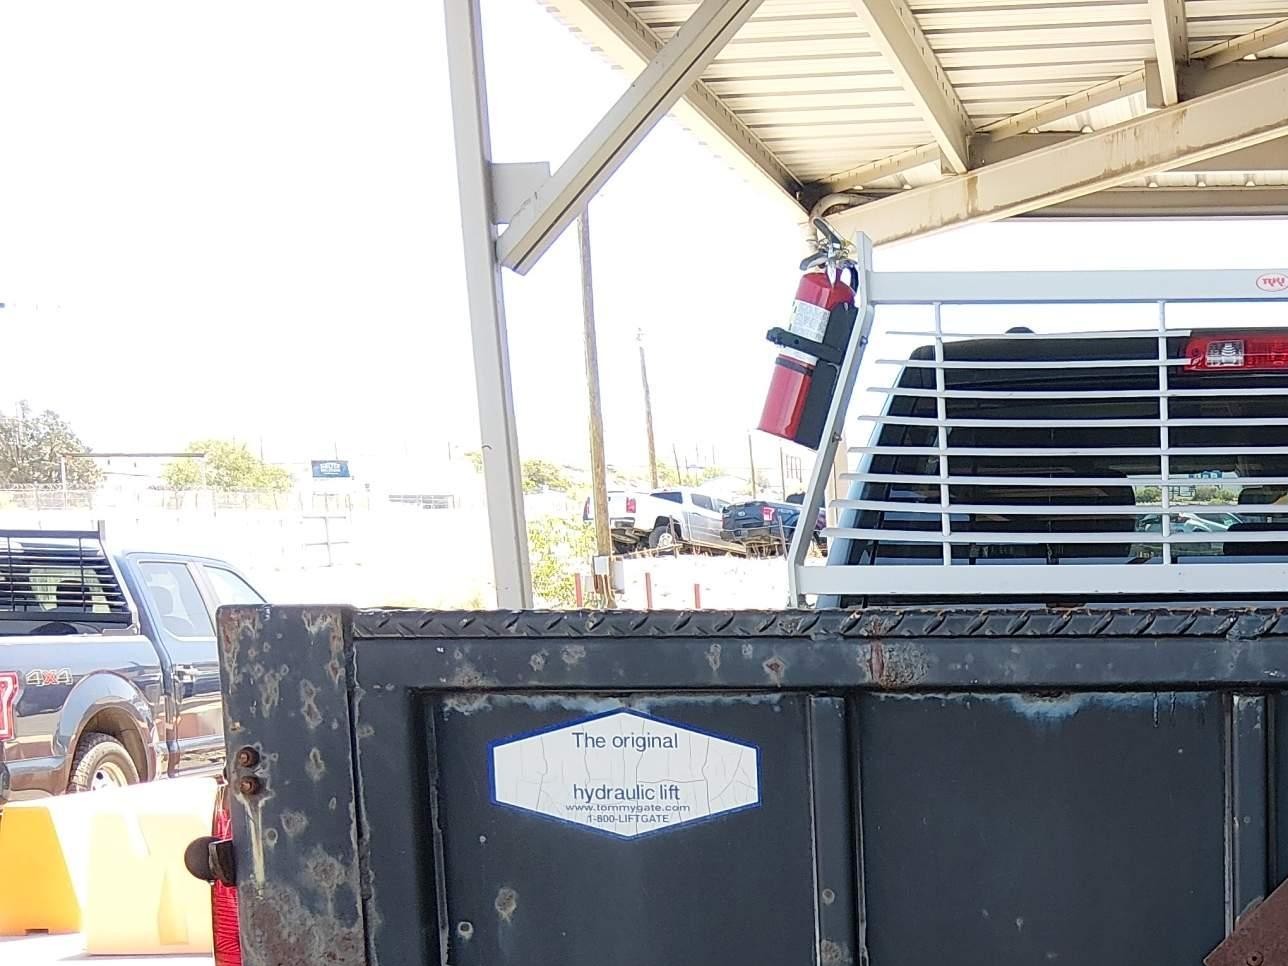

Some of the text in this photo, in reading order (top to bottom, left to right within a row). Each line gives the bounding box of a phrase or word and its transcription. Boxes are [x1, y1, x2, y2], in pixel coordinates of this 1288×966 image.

[572, 732, 679, 753] The original
[573, 784, 680, 803] hydraulic lift
[565, 804, 690, 814] www.tommygate.com
[587, 814, 670, 824] 1-800-LIFTGATE
